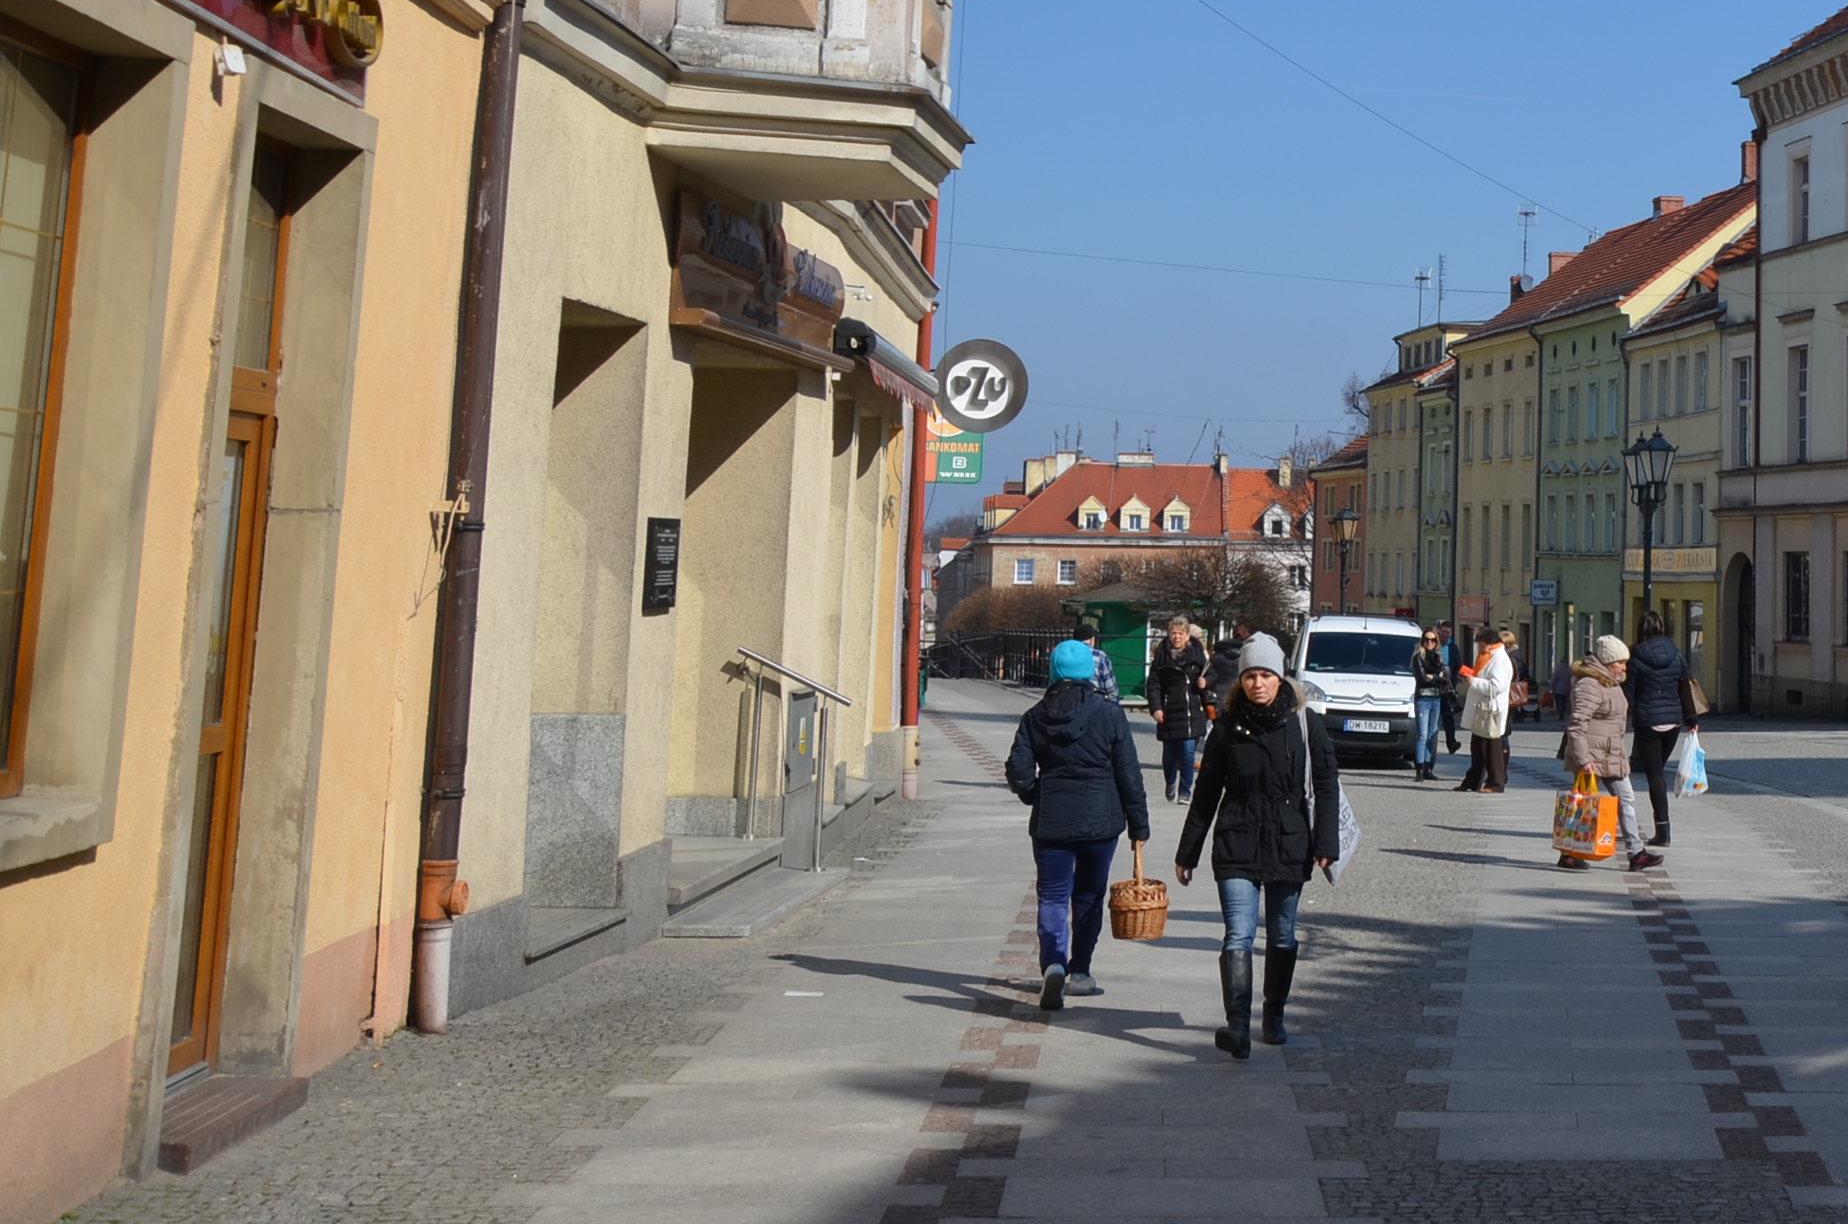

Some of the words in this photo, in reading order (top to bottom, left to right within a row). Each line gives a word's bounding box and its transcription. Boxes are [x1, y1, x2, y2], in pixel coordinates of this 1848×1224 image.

[950, 367, 1007, 411] PZU
[926, 441, 980, 453] ANKOMAT
[1677, 552, 1712, 568] PIEKARNIA
[1348, 720, 1361, 729] DW
